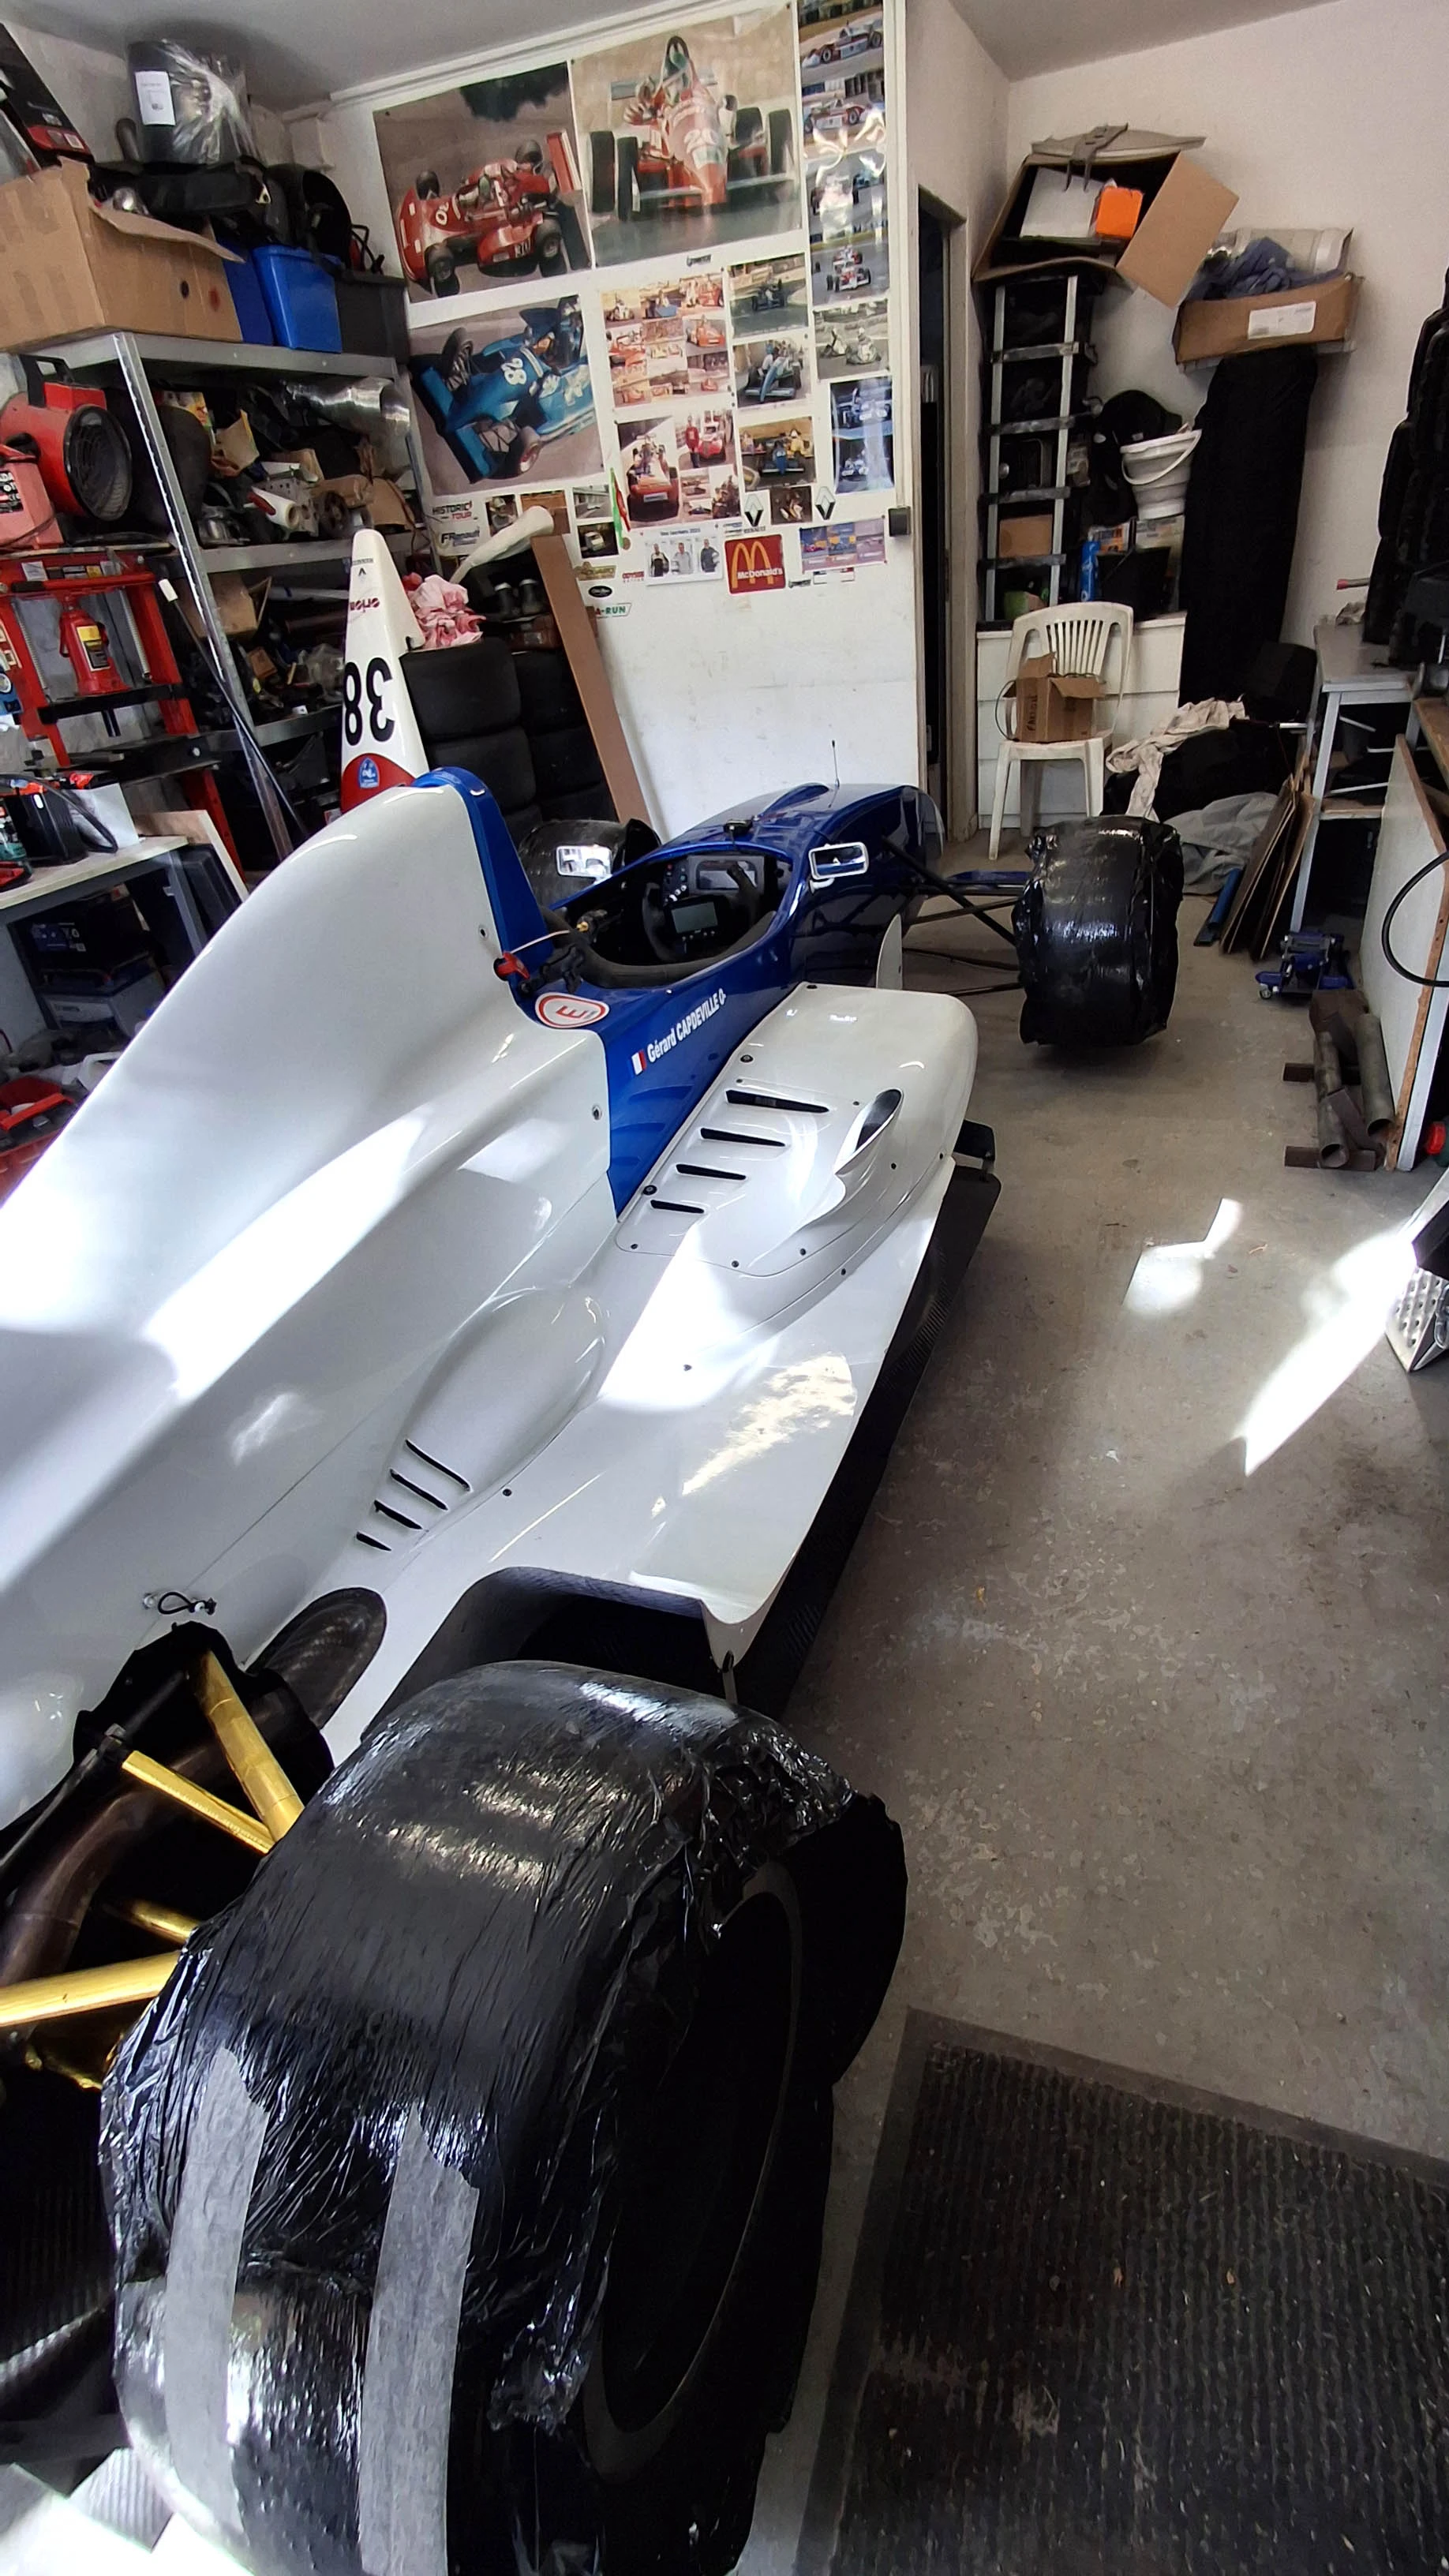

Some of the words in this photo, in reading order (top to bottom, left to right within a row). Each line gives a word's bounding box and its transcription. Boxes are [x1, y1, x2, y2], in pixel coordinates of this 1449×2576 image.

[737, 567, 783, 580] McDonald's
[343, 657, 395, 747] 38
[647, 1028, 677, 1063] Gérard
[676, 992, 720, 1042] CAPDEVILLE
